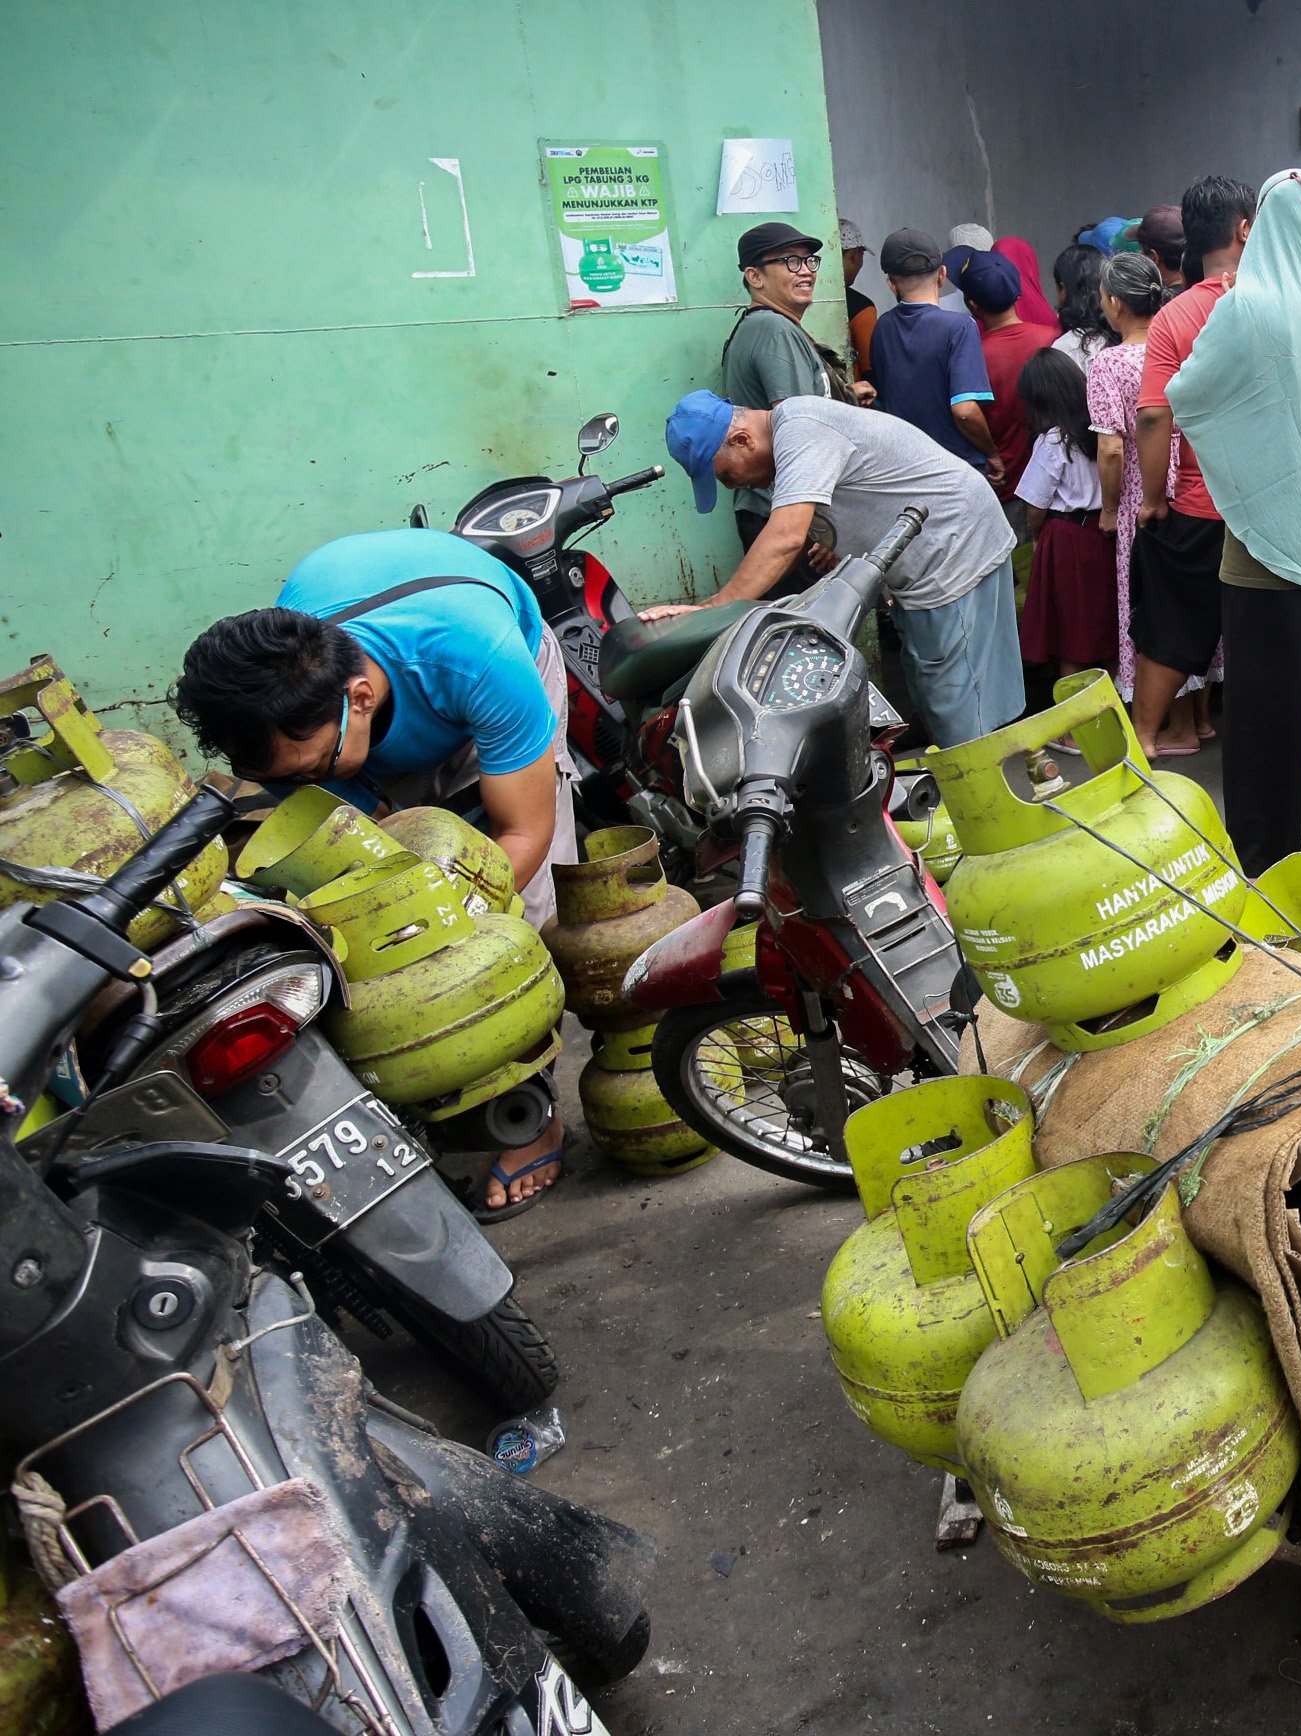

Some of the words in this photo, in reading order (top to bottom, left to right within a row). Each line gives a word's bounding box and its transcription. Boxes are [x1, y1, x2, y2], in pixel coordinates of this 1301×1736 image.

[564, 176, 581, 184] LPG
[584, 175, 624, 183] TABUNG
[627, 175, 633, 183] 3
[636, 175, 649, 183] KG
[579, 167, 632, 175] PEMBELIAN
[580, 184, 636, 198] WAJIB
[562, 200, 638, 208] MENUNJUKKAN
[641, 199, 658, 207] KTP
[1096, 873, 1162, 920] HANYA
[1162, 842, 1211, 882] UNTUK
[1202, 869, 1239, 906] MISKIN
[436, 903, 458, 928] 25
[376, 1143, 418, 1177] 12
[496, 1440, 534, 1460] Gunung
